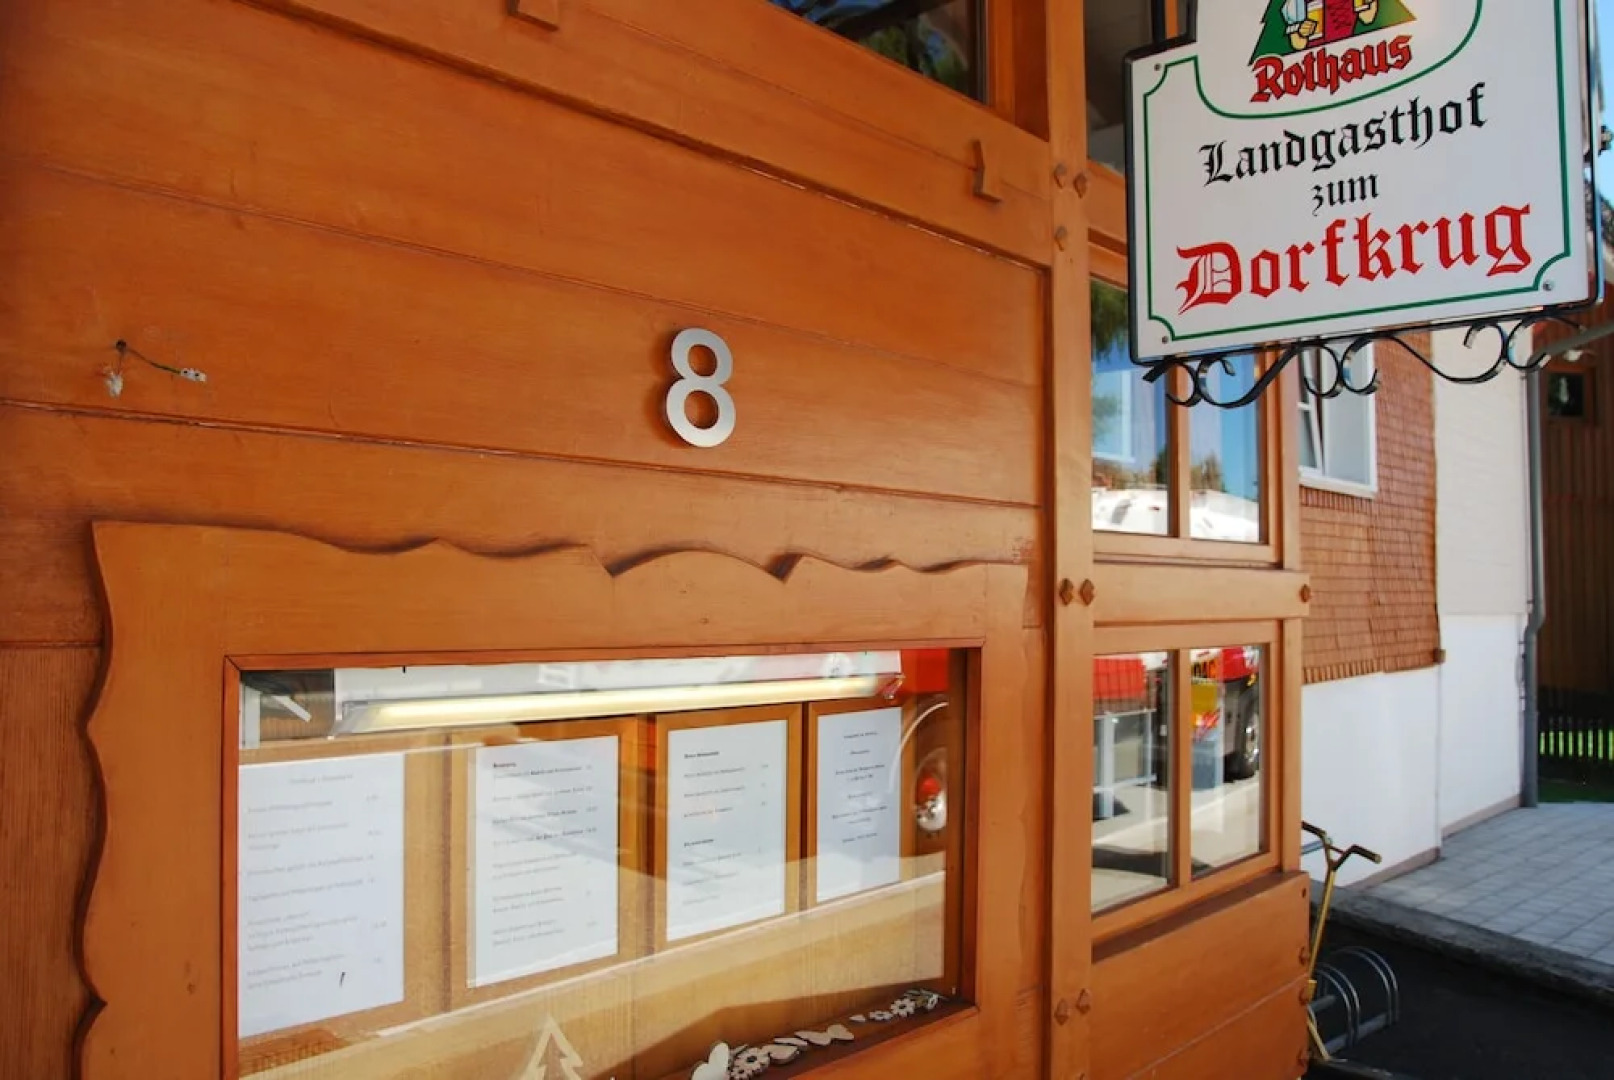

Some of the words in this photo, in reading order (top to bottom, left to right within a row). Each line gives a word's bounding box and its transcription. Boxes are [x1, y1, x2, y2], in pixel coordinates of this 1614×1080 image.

[1250, 35, 1413, 103] Rothaus
[1199, 82, 1486, 187] Landgasthof
[1311, 173, 1379, 216] zum
[1175, 203, 1531, 315] Dorfkrug
[665, 327, 736, 448] 8
